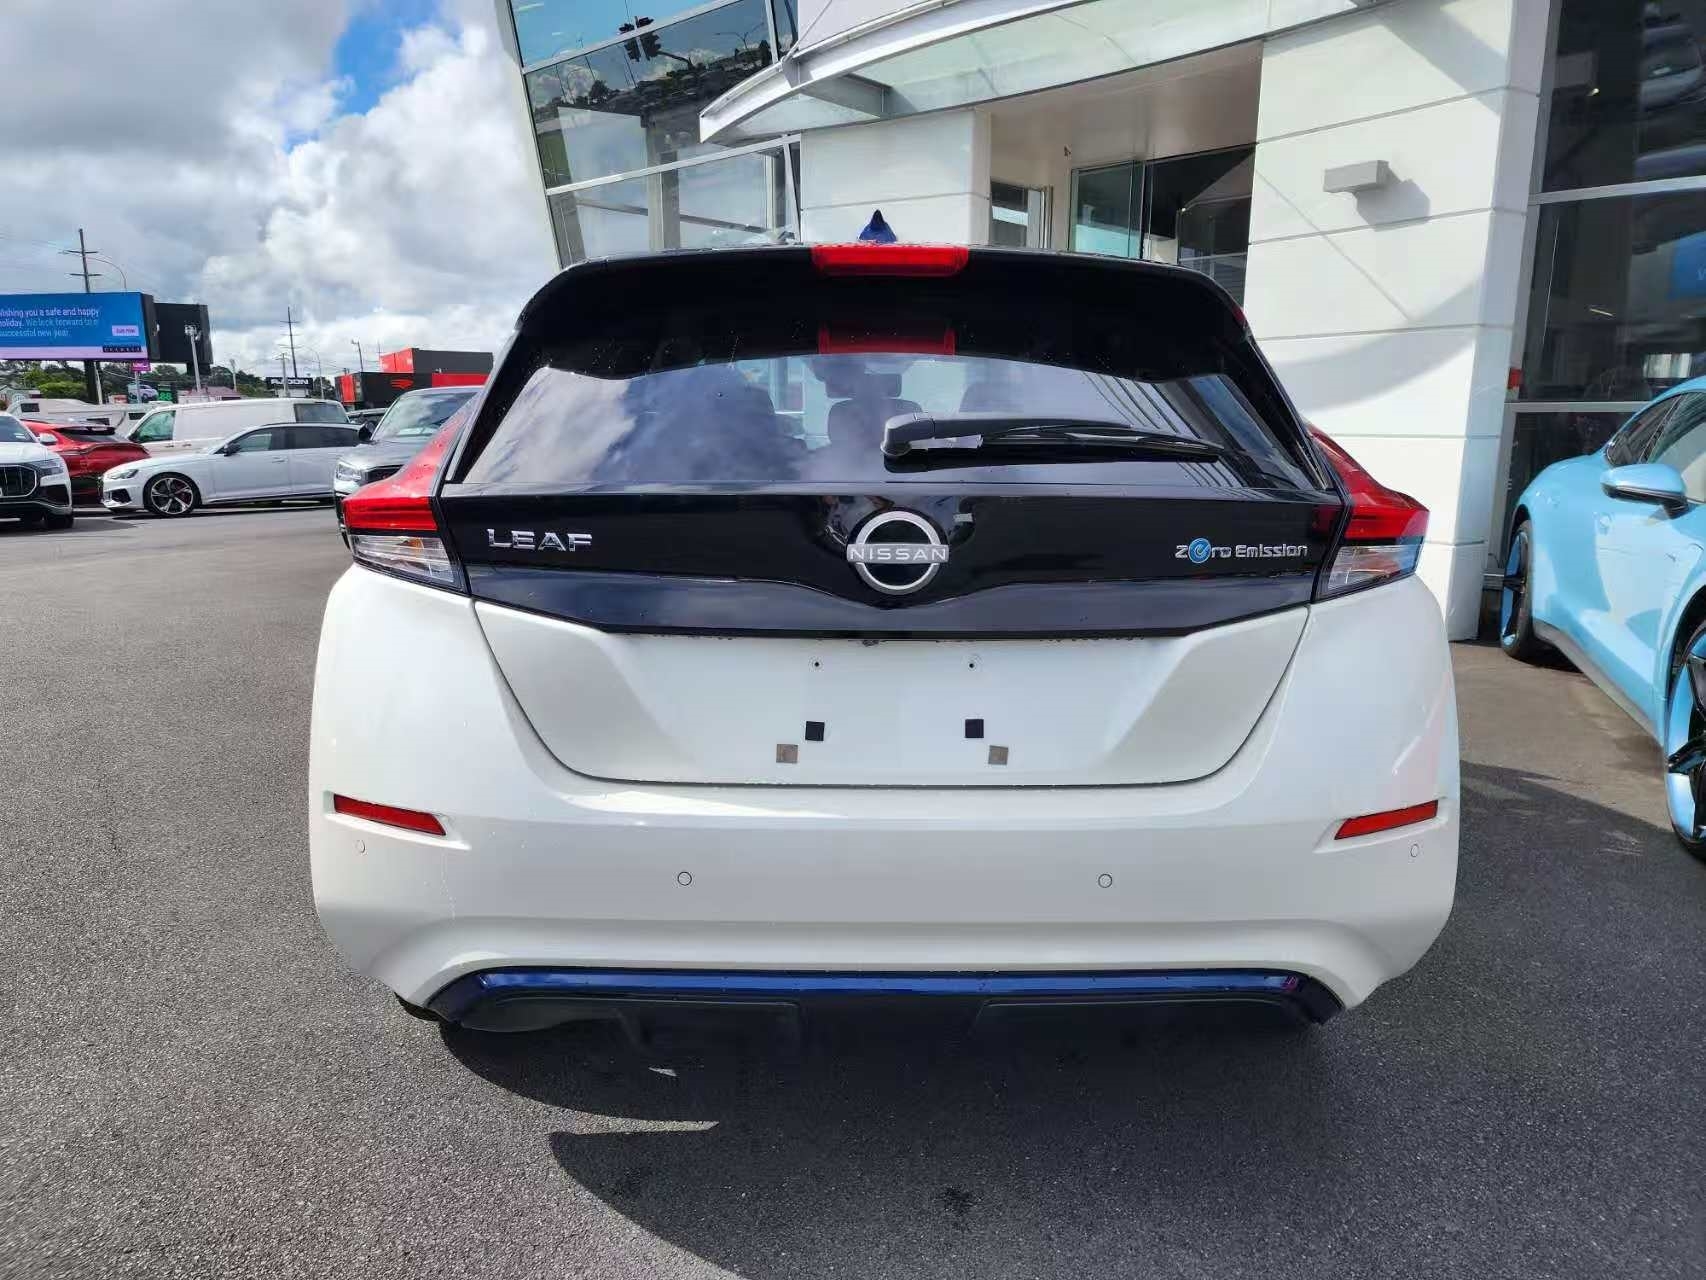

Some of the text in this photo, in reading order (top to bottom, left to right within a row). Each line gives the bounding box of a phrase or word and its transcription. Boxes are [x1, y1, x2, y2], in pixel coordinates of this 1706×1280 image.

[26, 309, 38, 318] you
[45, 306, 62, 316] safe
[62, 306, 77, 316] and
[77, 306, 99, 318] happy
[487, 528, 593, 552] LEAF
[850, 548, 946, 561] NISSAN
[1235, 543, 1308, 558] Emission
